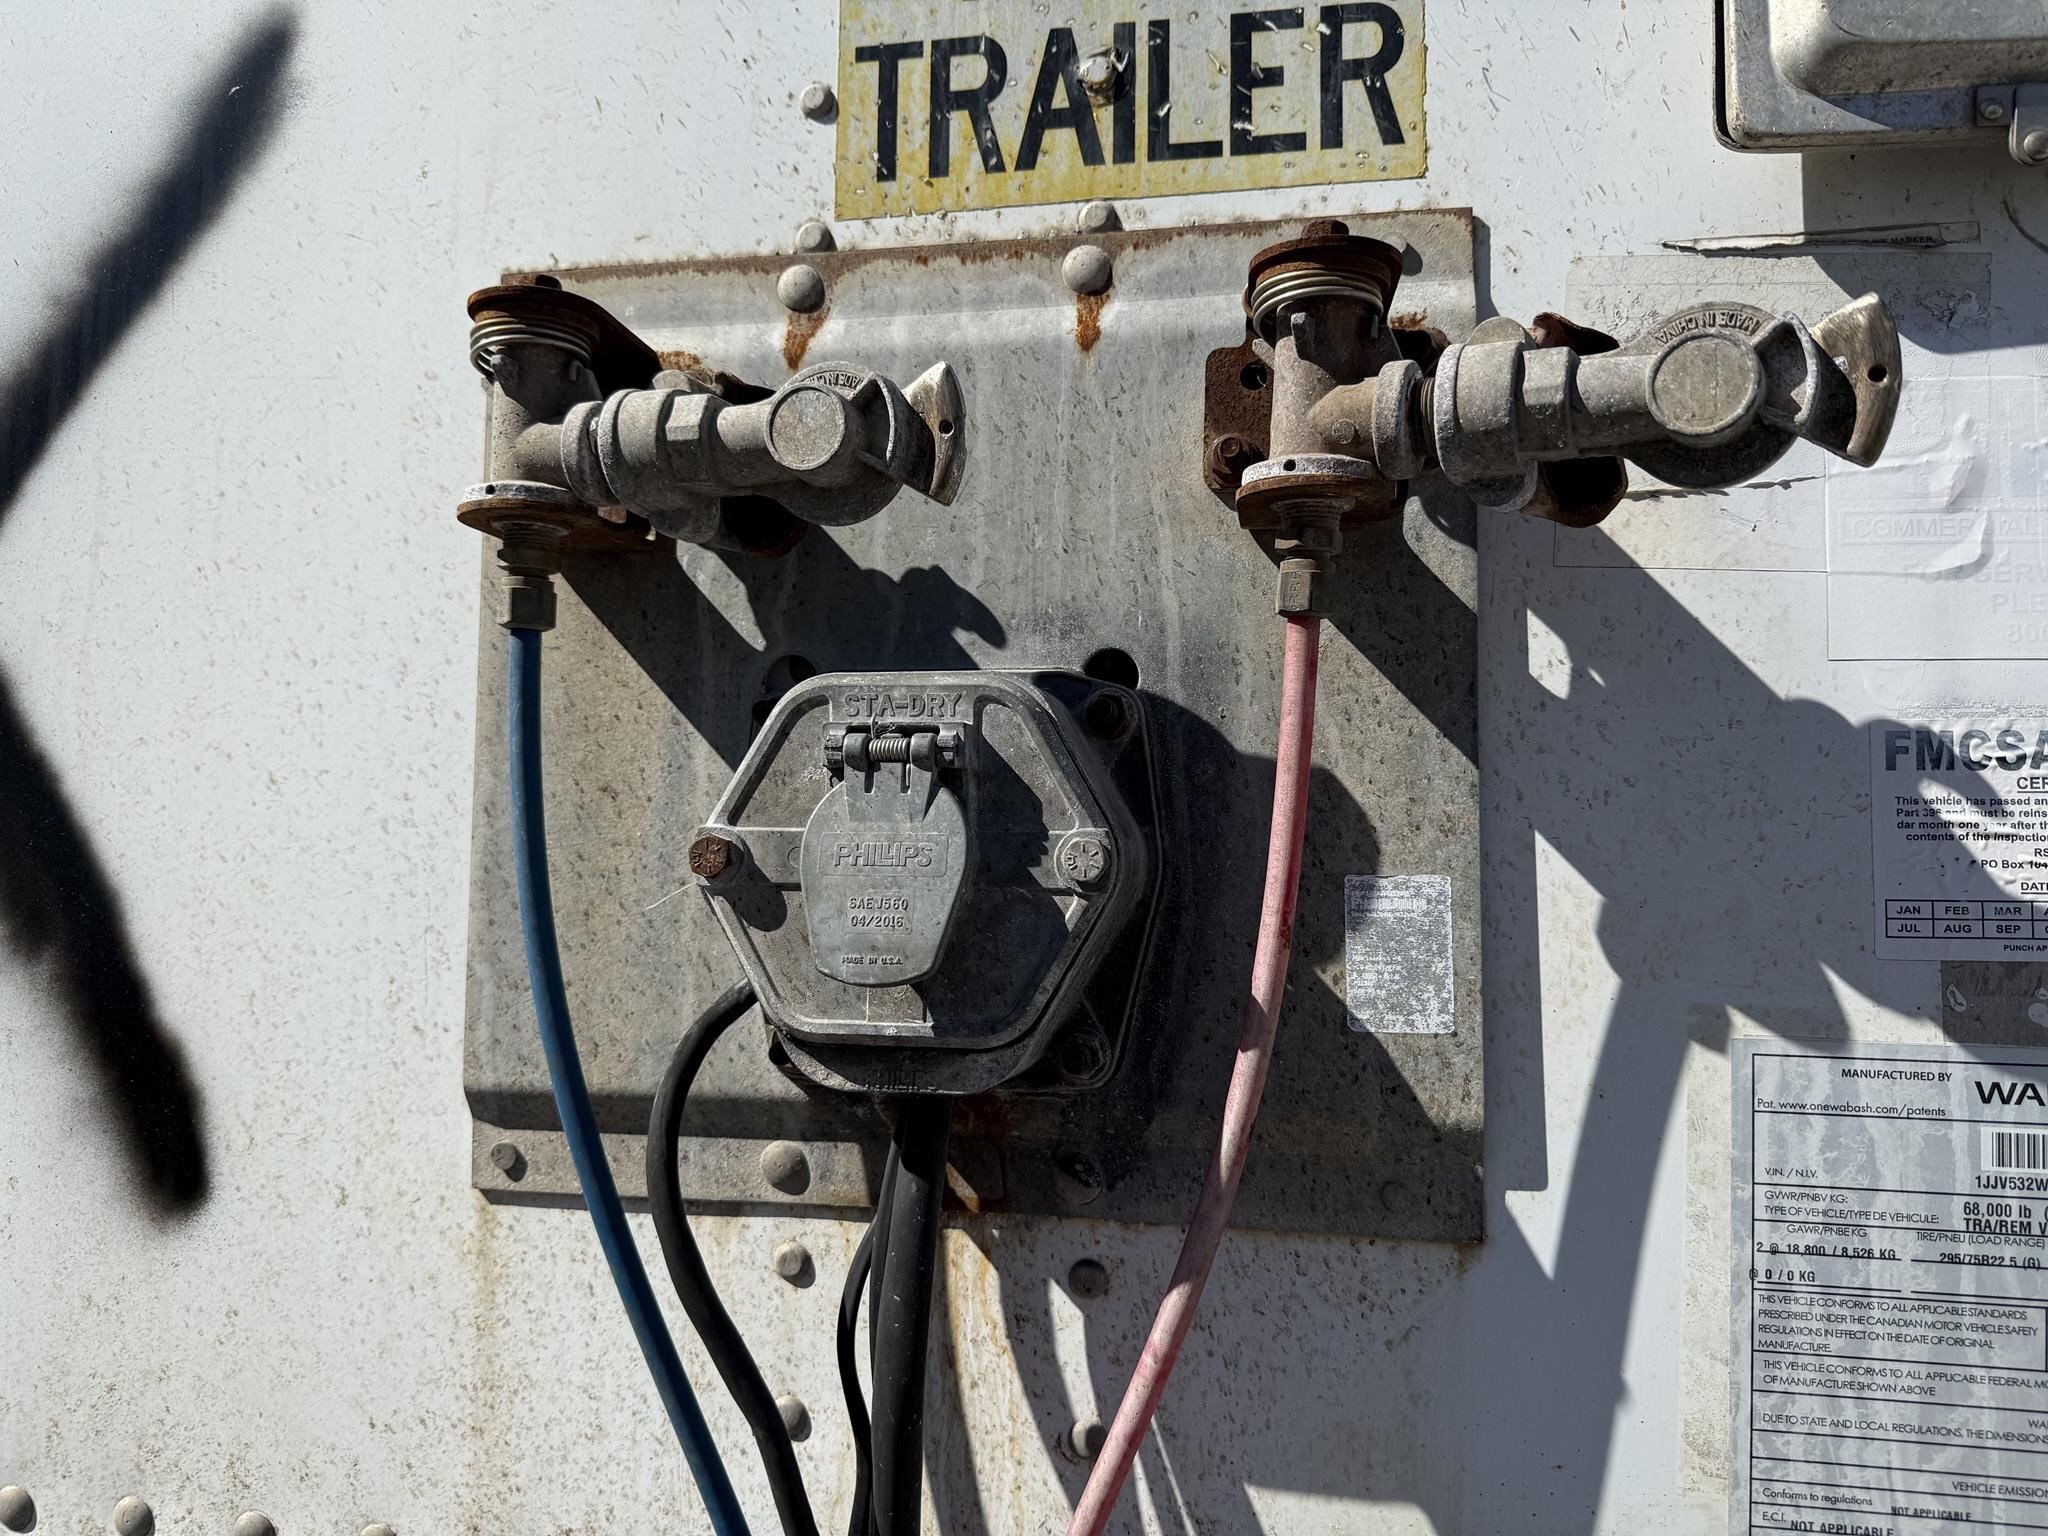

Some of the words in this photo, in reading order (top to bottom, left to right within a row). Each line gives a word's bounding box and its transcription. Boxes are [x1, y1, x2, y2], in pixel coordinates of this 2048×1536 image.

[855, 2, 1405, 183] TRAILER
[1700, 311, 1716, 328] IN
[1719, 311, 1761, 336] MADE
[1654, 317, 1699, 344] CHINA
[1853, 516, 2040, 538] COMMERIAL
[843, 693, 963, 718] STA-DRY
[1895, 797, 1919, 806] This
[1923, 796, 1962, 806] vehicle
[1965, 796, 1986, 806] has
[1990, 796, 2031, 808] passed
[1896, 808, 1920, 818] Part
[1969, 808, 1998, 818] must
[2001, 808, 2015, 818] be
[1897, 820, 1916, 829] dar
[1918, 820, 1954, 829] month
[2010, 821, 2038, 830] after
[1906, 832, 1955, 841] contents
[1958, 831, 1971, 841] of
[1972, 832, 1991, 841] the
[1993, 832, 2048, 844] Inspectio
[833, 842, 935, 867] PHILLIPS
[1981, 859, 1998, 869] PO
[2001, 859, 2025, 869] Box
[2020, 882, 2048, 891] DAT
[849, 896, 874, 910] SAE
[876, 896, 909, 910] J560
[1896, 906, 1921, 915] JAN
[1944, 906, 1970, 915] FEB
[1993, 907, 2022, 916] MAR
[850, 915, 904, 928] 04/2016
[1897, 923, 1921, 933] JUL
[1943, 924, 1972, 934] AUG
[1995, 924, 2021, 934] SEP
[2003, 944, 2034, 952] PUNCH
[841, 955, 864, 965] MADE
[868, 955, 878, 965] IN
[881, 955, 904, 965] U.S.A.
[1841, 1068, 1935, 1081] MANUFACTURED
[1938, 1072, 1953, 1082] BY
[1975, 1081, 2048, 1107] WA
[1757, 1098, 1776, 1109] Pat.
[1778, 1101, 1947, 1118] www.onewabash.com/patents
[1787, 1167, 1794, 1179] /
[1795, 1169, 1818, 1180] N.I.V.
[1764, 1190, 1827, 1203] GVWR/PNBV
[1829, 1193, 1848, 1204] KG:
[1764, 1205, 1787, 1215] TYPE
[1788, 1206, 1803, 1216] OF
[1804, 1206, 1872, 1221] VEHICLE/TYPE
[1873, 1211, 1887, 1221] DE
[1888, 1212, 1940, 1224] VEHICULE:
[1963, 1201, 2012, 1218] 68,000
[2019, 1205, 2032, 1219] lb
[1786, 1224, 1850, 1237] GAWR/PNBE
[1851, 1227, 1867, 1238] KG
[1963, 1217, 2032, 1235] TRA/REM
[1915, 1231, 1966, 1243] TIRE/PNEU
[1756, 1241, 1764, 1252] 2
[1770, 1242, 1779, 1256] @
[1786, 1243, 1826, 1257] 18,800
[1841, 1246, 1875, 1260] 8,526
[1879, 1248, 1896, 1260] KG
[2022, 1257, 2041, 1270] (G)
[1765, 1268, 1772, 1280] 0
[1777, 1269, 1783, 1280] /
[1787, 1270, 1794, 1281] 0
[1799, 1270, 1816, 1283] KG
[1758, 1293, 1776, 1304] THIS
[1777, 1295, 1816, 1307] VEHICLE
[1816, 1297, 1875, 1311] CONFORMS
[1877, 1301, 1890, 1311] TO
[1891, 1303, 1908, 1313] ALL
[1909, 1304, 1968, 1317] APPLICABLE
[1967, 1307, 2028, 1321] STANDARDS
[1758, 1308, 1814, 1321] PRESCRIBED
[1815, 1312, 1848, 1324] UNDER
[1848, 1314, 1866, 1325] THE
[1866, 1316, 1923, 1329] CANADIAN
[1923, 1320, 1963, 1332] MOTOR
[1963, 1322, 2005, 1335] VEHICLE
[2004, 1325, 2039, 1337] SAFETY
[1758, 1323, 1823, 1338] REGULATIONS
[1823, 1328, 1834, 1338] IN
[1835, 1329, 1868, 1340] EFFECT
[1867, 1331, 1885, 1341] ON
[1886, 1332, 1903, 1343] THE
[1904, 1333, 1929, 1345] DATE
[1930, 1335, 1945, 1345] OF
[1945, 1336, 1995, 1349] ORIGINAL
[1758, 1339, 1832, 1352] MANUFACTURE.
[1763, 1359, 1782, 1370] THIS
[1783, 1361, 1825, 1373] VEHICLE
[1826, 1364, 1888, 1378] CONFORMS
[1889, 1368, 1903, 1379] TO
[1904, 1370, 1923, 1381] ALL
[1924, 1371, 1987, 1385] APPLICABLE
[1987, 1375, 2033, 1388] FEDERAL
[1763, 1374, 1778, 1385] OF
[1779, 1377, 1857, 1391] MANUFACTURE
[1857, 1381, 1898, 1393] SHOWN
[1898, 1385, 1937, 1396] ABOVE
[1762, 1413, 1784, 1424] DUE
[1784, 1415, 1799, 1425] TO
[1800, 1416, 1828, 1427] STATE
[1828, 1419, 1853, 1429] AND
[1854, 1420, 1891, 1432] LOCAL
[1965, 1428, 1985, 1440] THE
[2028, 1419, 2048, 1430] WA
[1951, 1481, 1996, 1494] VEHICLE
[1762, 1488, 1808, 1500] Conforms
[1810, 1492, 1819, 1502] to
[1821, 1493, 1873, 1506] regulations
[1762, 1511, 1786, 1523] E.C.I.
[1891, 1505, 1909, 1516] NOT
[1913, 1508, 1972, 1521] APPLICABLE
[1790, 1520, 1815, 1532] NOT
[1819, 1522, 1894, 1536] APPLICABLE
